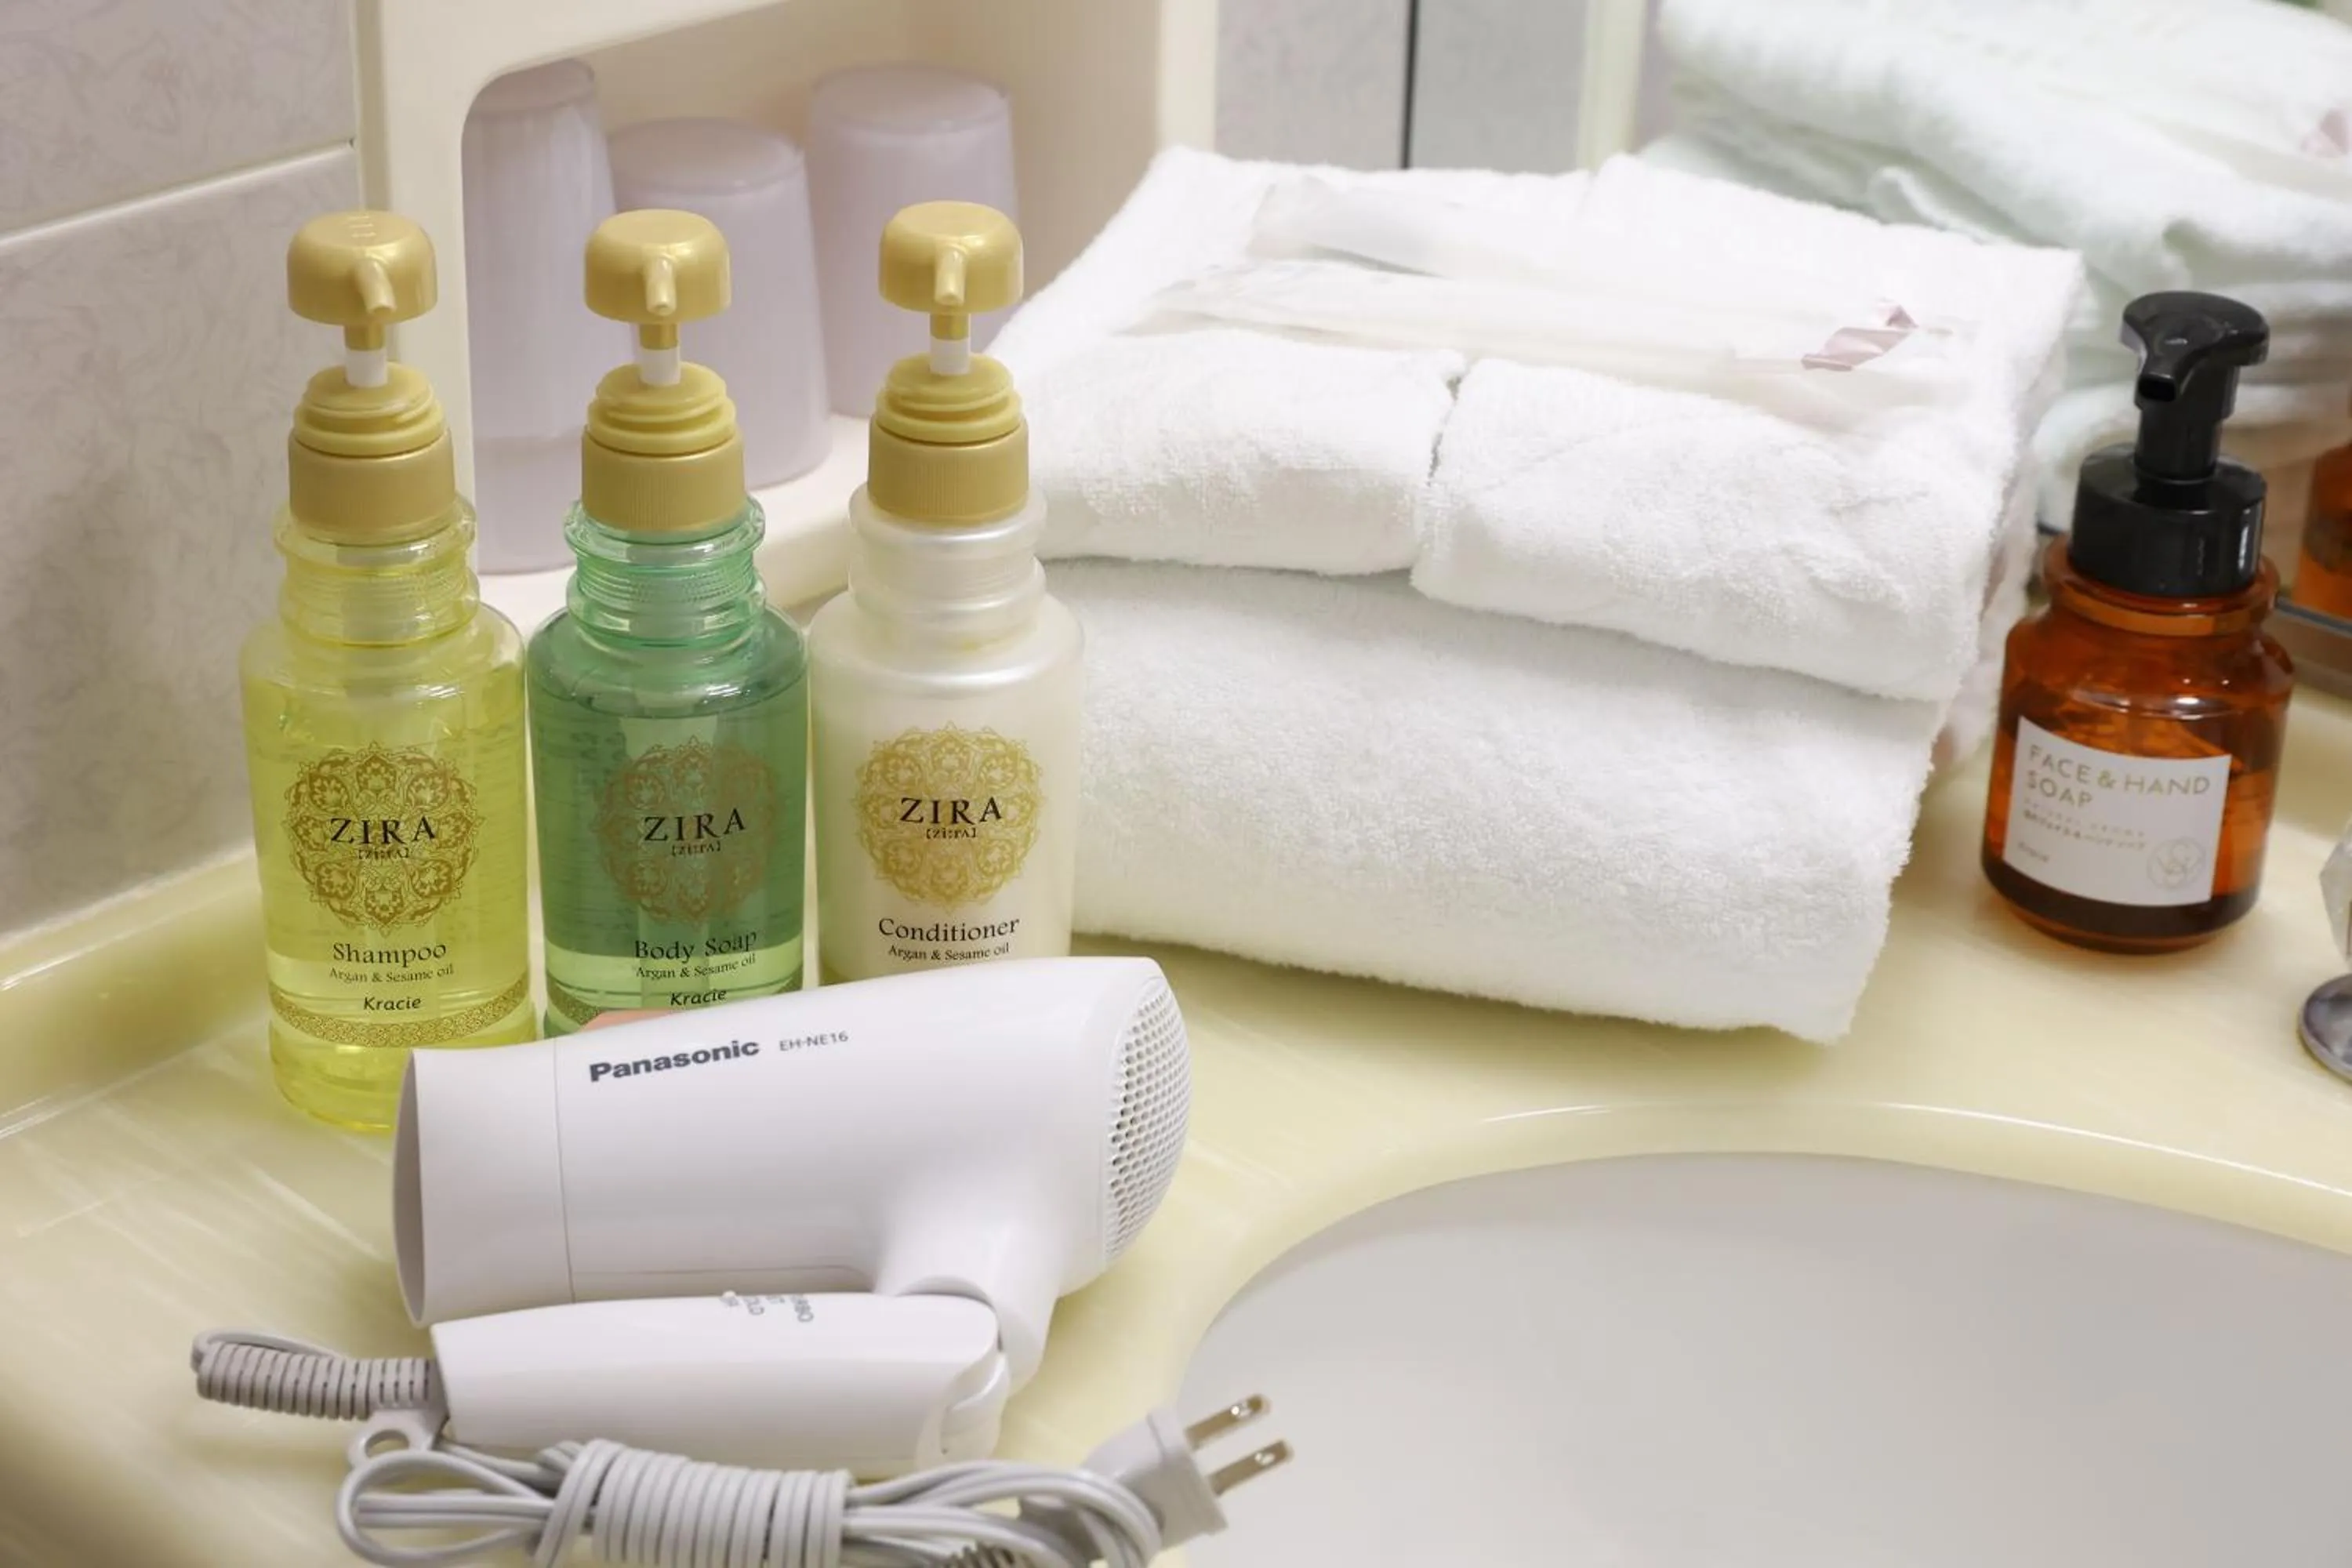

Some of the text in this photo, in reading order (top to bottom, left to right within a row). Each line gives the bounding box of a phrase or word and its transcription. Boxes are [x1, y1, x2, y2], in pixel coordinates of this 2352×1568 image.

[2027, 745, 2092, 783] FACE
[2124, 775, 2211, 796] HAND
[2027, 769, 2092, 808] SOAP
[644, 808, 746, 842] ZIRA
[899, 797, 1003, 826] ZIRA
[329, 816, 437, 845] ZIRA
[878, 917, 1021, 942] Conditioner
[332, 942, 447, 968] Shampoo
[635, 931, 757, 964] Body Soap
[887, 942, 1010, 963] Argan & Sesame oil
[329, 964, 455, 984] Argan & Sesame oil
[636, 953, 757, 981] Argan & Sesame oil
[363, 996, 422, 1011] Kracie
[670, 988, 728, 1007] Kracie
[589, 1029, 849, 1083] Panasonic EH-NE16
